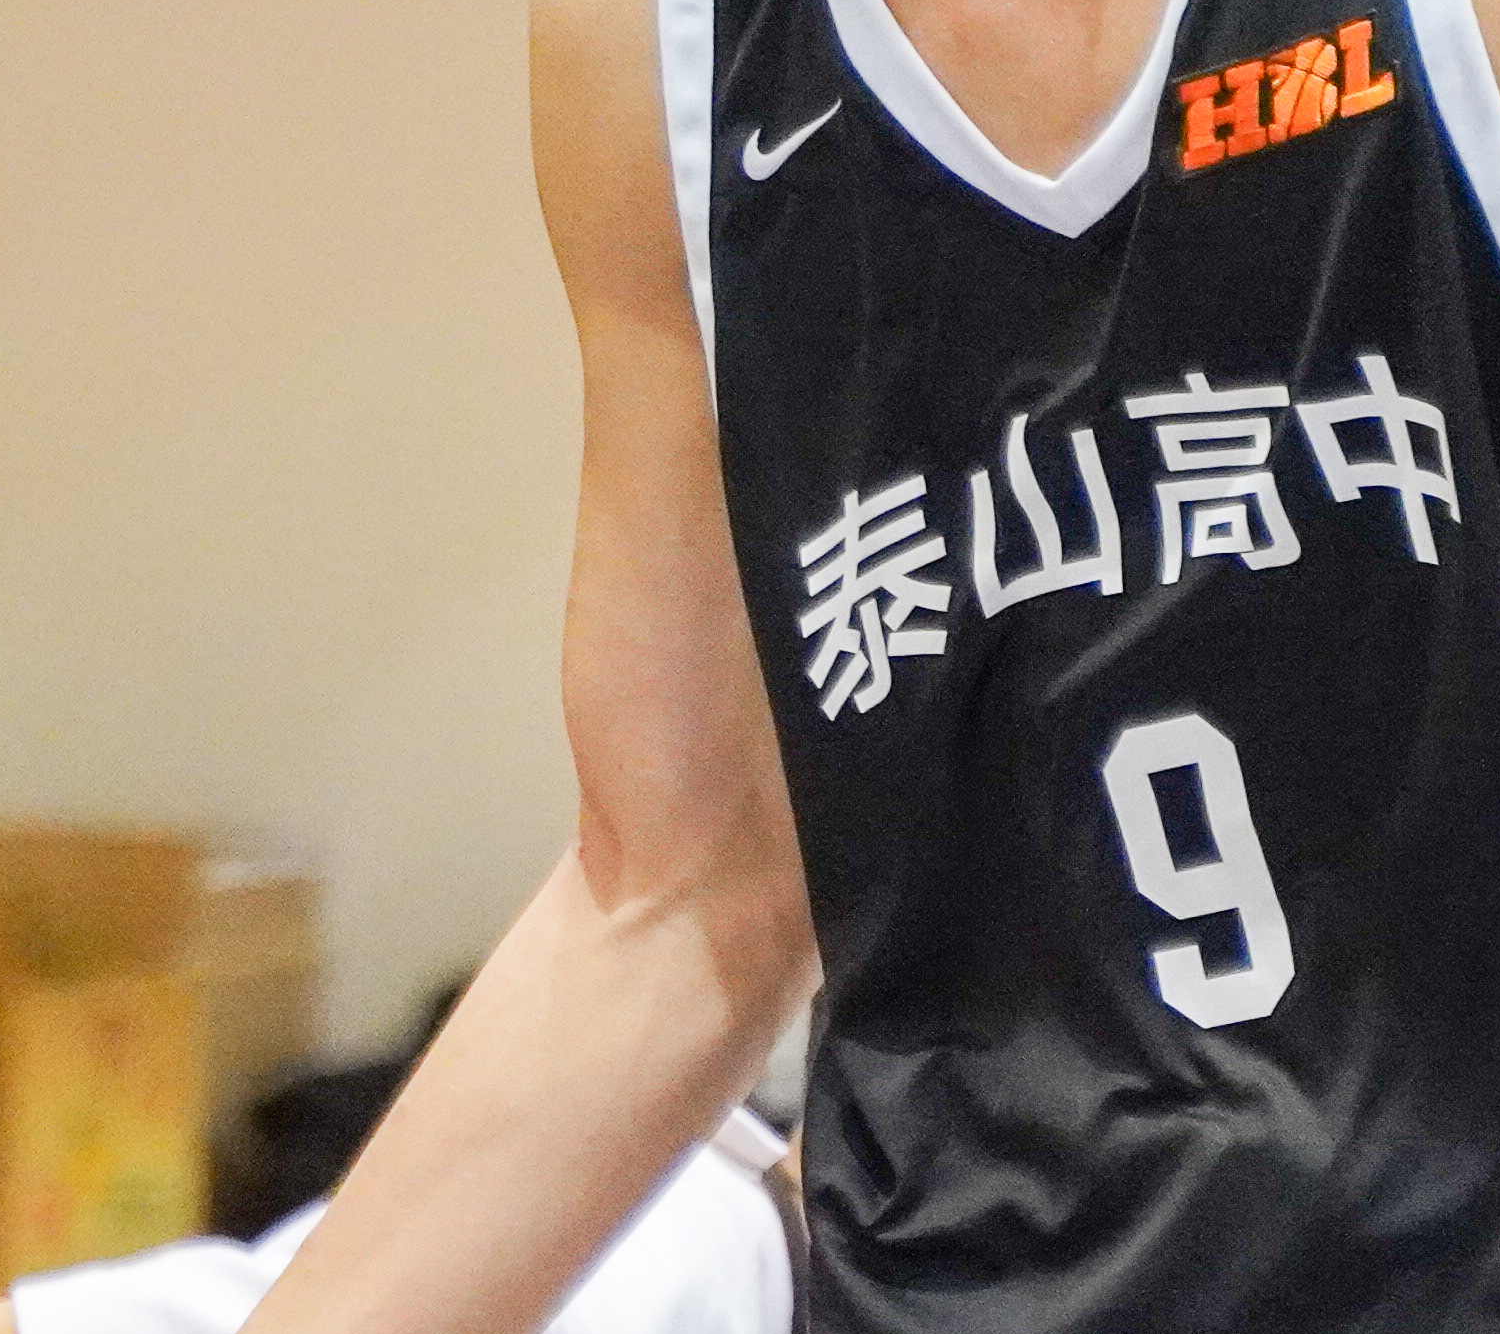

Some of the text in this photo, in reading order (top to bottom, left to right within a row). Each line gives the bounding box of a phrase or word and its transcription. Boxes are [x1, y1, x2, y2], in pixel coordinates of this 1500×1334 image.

[1179, 19, 1396, 170] HBL
[800, 355, 1462, 722] 泰山高中
[1103, 714, 1297, 1029] 9
